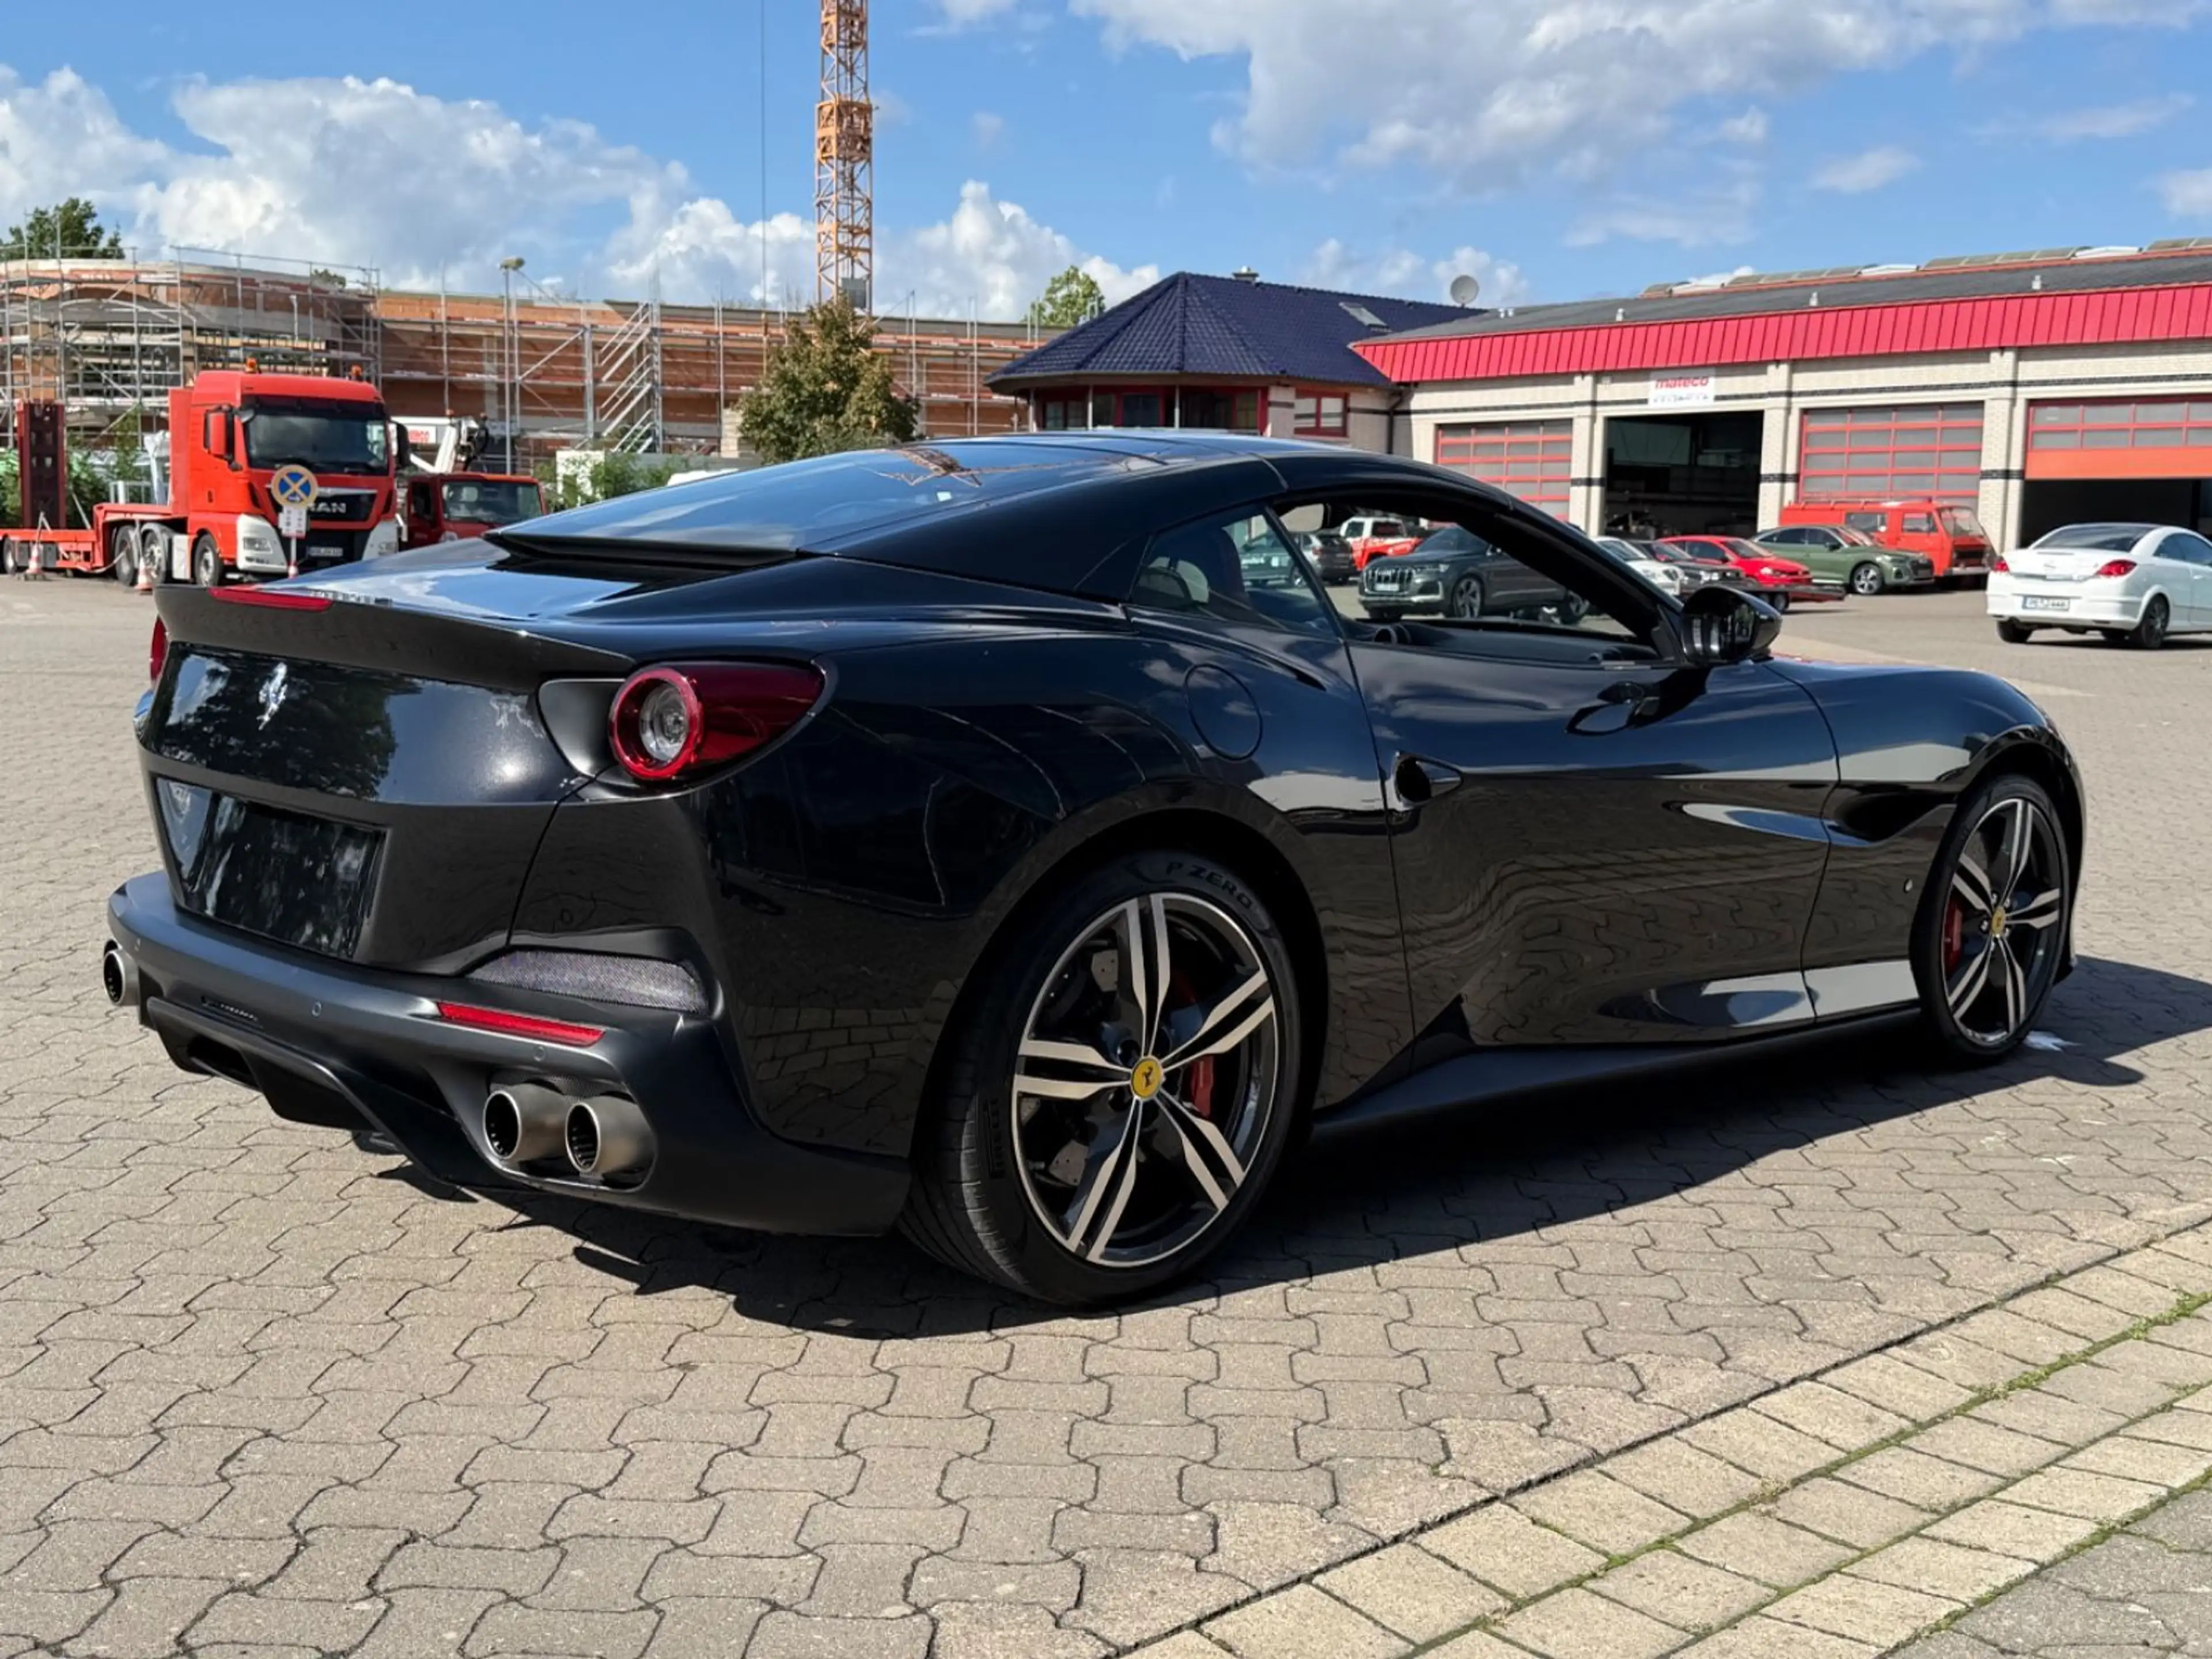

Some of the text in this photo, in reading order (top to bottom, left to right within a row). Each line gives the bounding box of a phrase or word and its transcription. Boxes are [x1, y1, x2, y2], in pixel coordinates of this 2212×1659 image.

[1654, 376, 1709, 389] mateco
[1166, 861, 1252, 908] P ZERO
